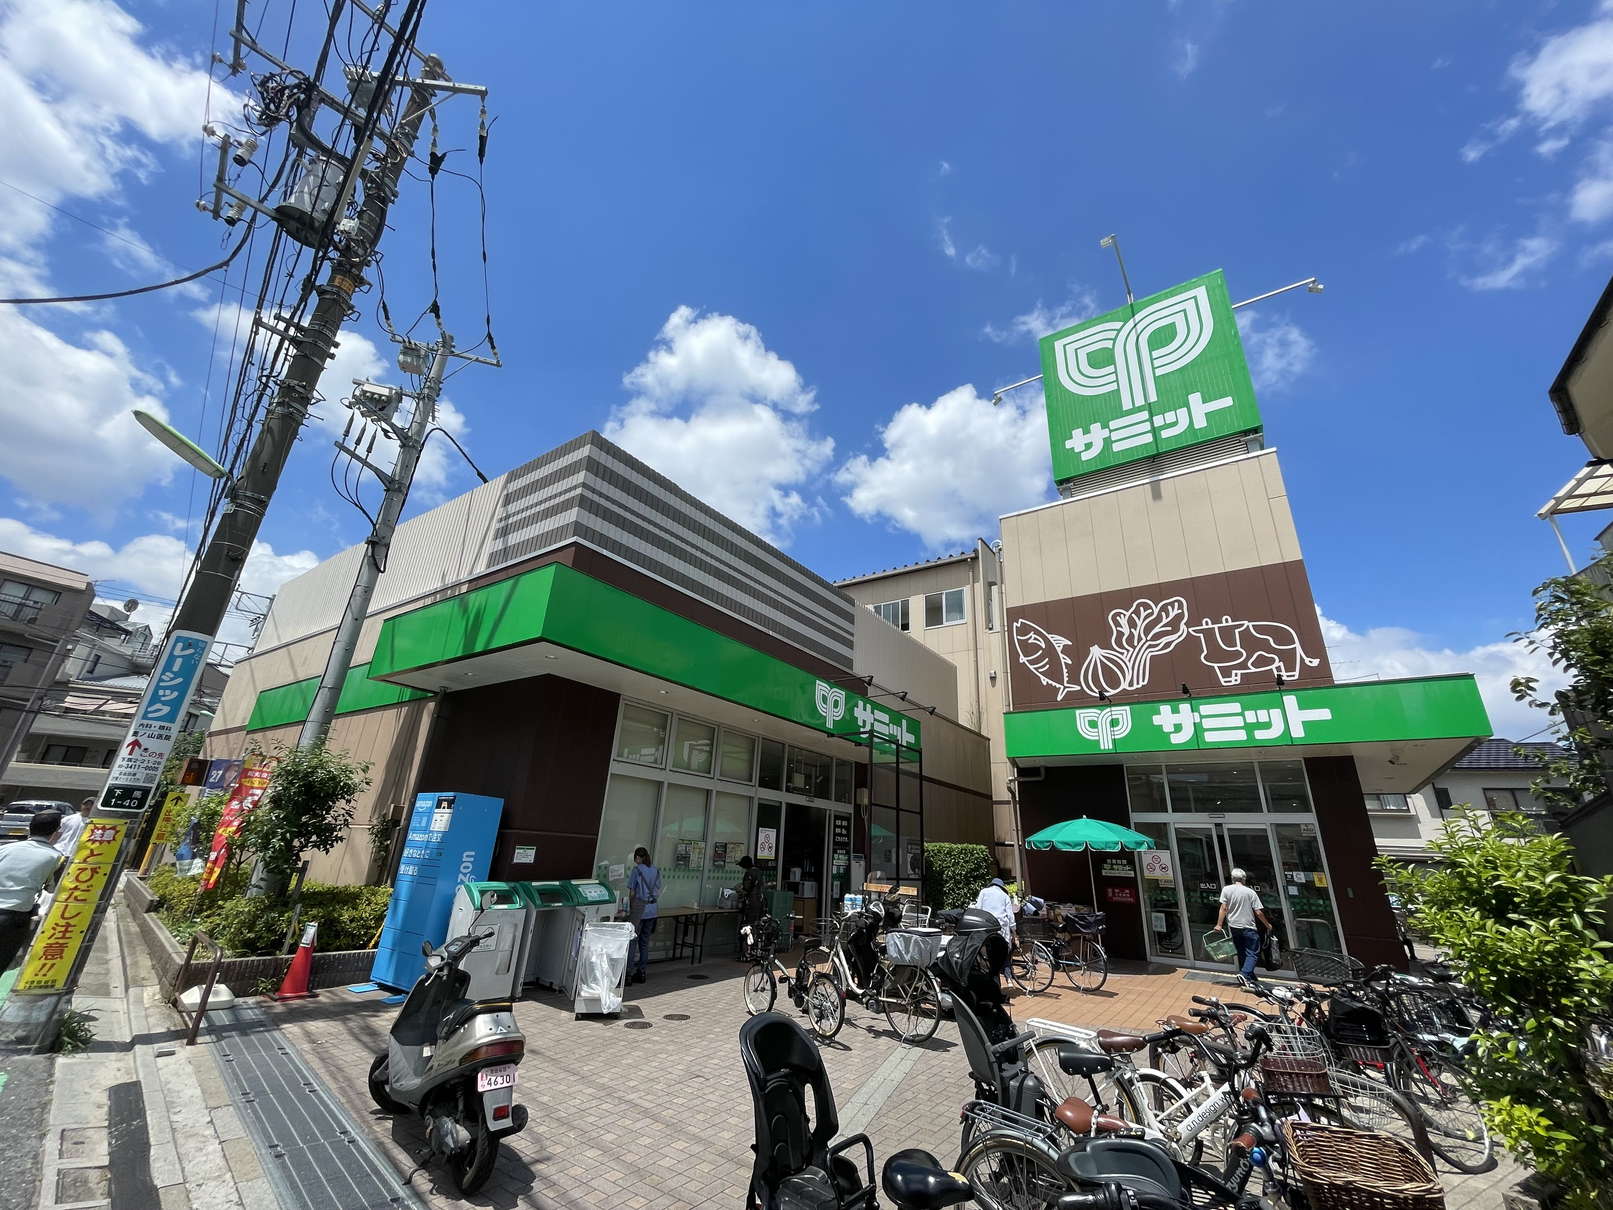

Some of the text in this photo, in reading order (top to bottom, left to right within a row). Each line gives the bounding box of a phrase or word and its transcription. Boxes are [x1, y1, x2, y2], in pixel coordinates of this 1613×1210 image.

[1065, 391, 1233, 461] サミット
[147, 642, 195, 718] レーシック
[854, 700, 916, 749] サミット
[1152, 695, 1332, 744] サミット
[111, 798, 138, 807] 1-40
[487, 1074, 511, 1088] 4630
